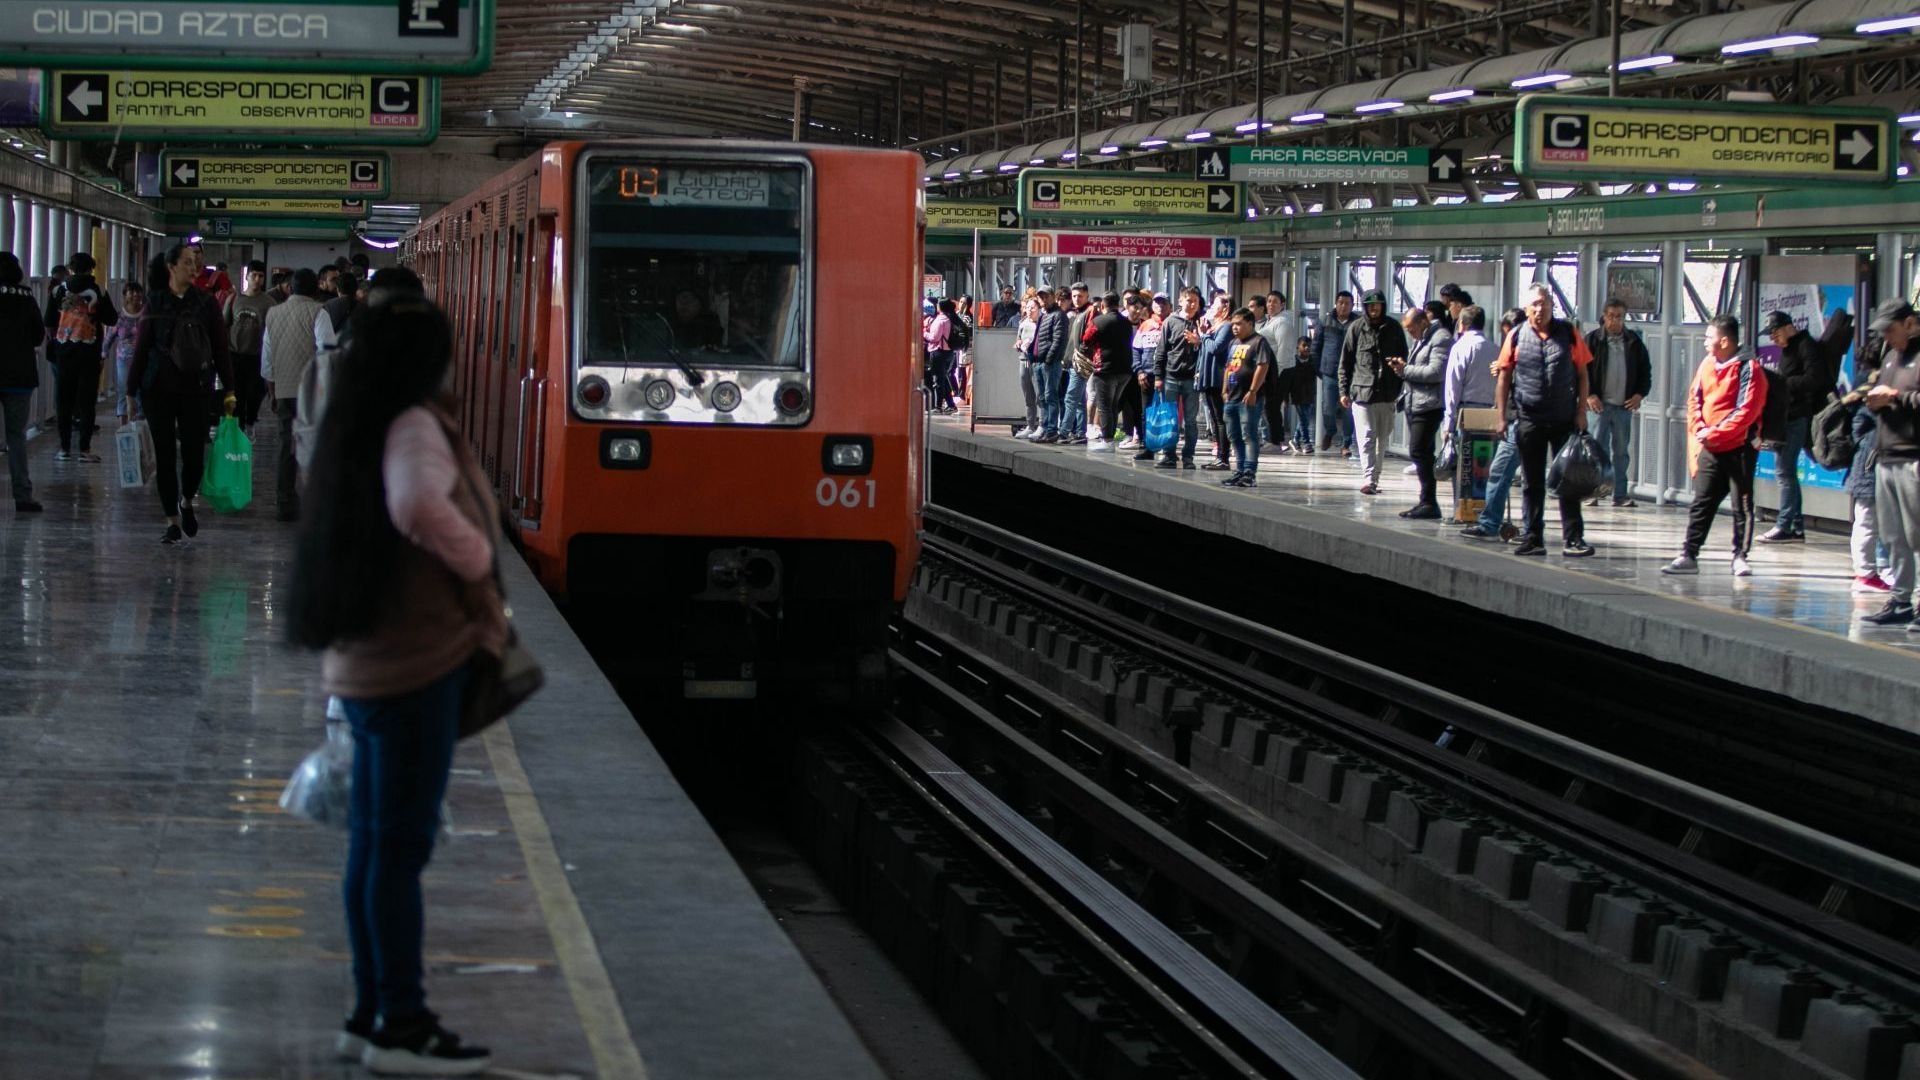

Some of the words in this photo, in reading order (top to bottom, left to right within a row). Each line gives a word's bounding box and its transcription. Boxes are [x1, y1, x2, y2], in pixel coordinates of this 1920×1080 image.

[33, 9, 163, 35] CIUDAD
[179, 12, 328, 39] AZTECA
[115, 80, 365, 100] CORRESPONDENCIA
[379, 80, 410, 112] C
[116, 104, 206, 117] PANTITLAN
[241, 106, 365, 119] OBSERVATORIO
[373, 115, 406, 125] LINEA
[1550, 115, 1582, 148] C
[1594, 121, 1830, 145] CORRESPONDENCIA
[1251, 149, 1297, 161] AREA
[1303, 150, 1408, 163] RESERVADA
[1544, 151, 1578, 160] LINEA
[1593, 145, 1680, 159] PANTITLAN
[1712, 149, 1830, 164] OBSERVATORIO
[202, 163, 347, 175] CORRESPONDENCIA
[355, 162, 374, 181] C
[1249, 168, 1285, 177] PARA
[1288, 169, 1349, 179] MUJERES
[1357, 169, 1367, 178] Y
[1370, 168, 1409, 179] NIÑOS
[202, 177, 256, 185] PANTITLAN
[275, 178, 347, 186] OBSERVATORIO
[679, 175, 762, 189] CIUDAD
[1037, 182, 1056, 201] C
[1063, 184, 1204, 198] CORRESPONDENCIA
[1064, 198, 1116, 207] PANTITLAN
[1133, 200, 1204, 209] OBSERVATORIO
[1088, 236, 1117, 246] AREA
[1122, 236, 1182, 247] EXCLUSIVA
[1083, 246, 1137, 255] MUJERES
[1142, 246, 1150, 256] Y
[1461, 440, 1472, 486] SPECTRA
[815, 477, 876, 508] 061
